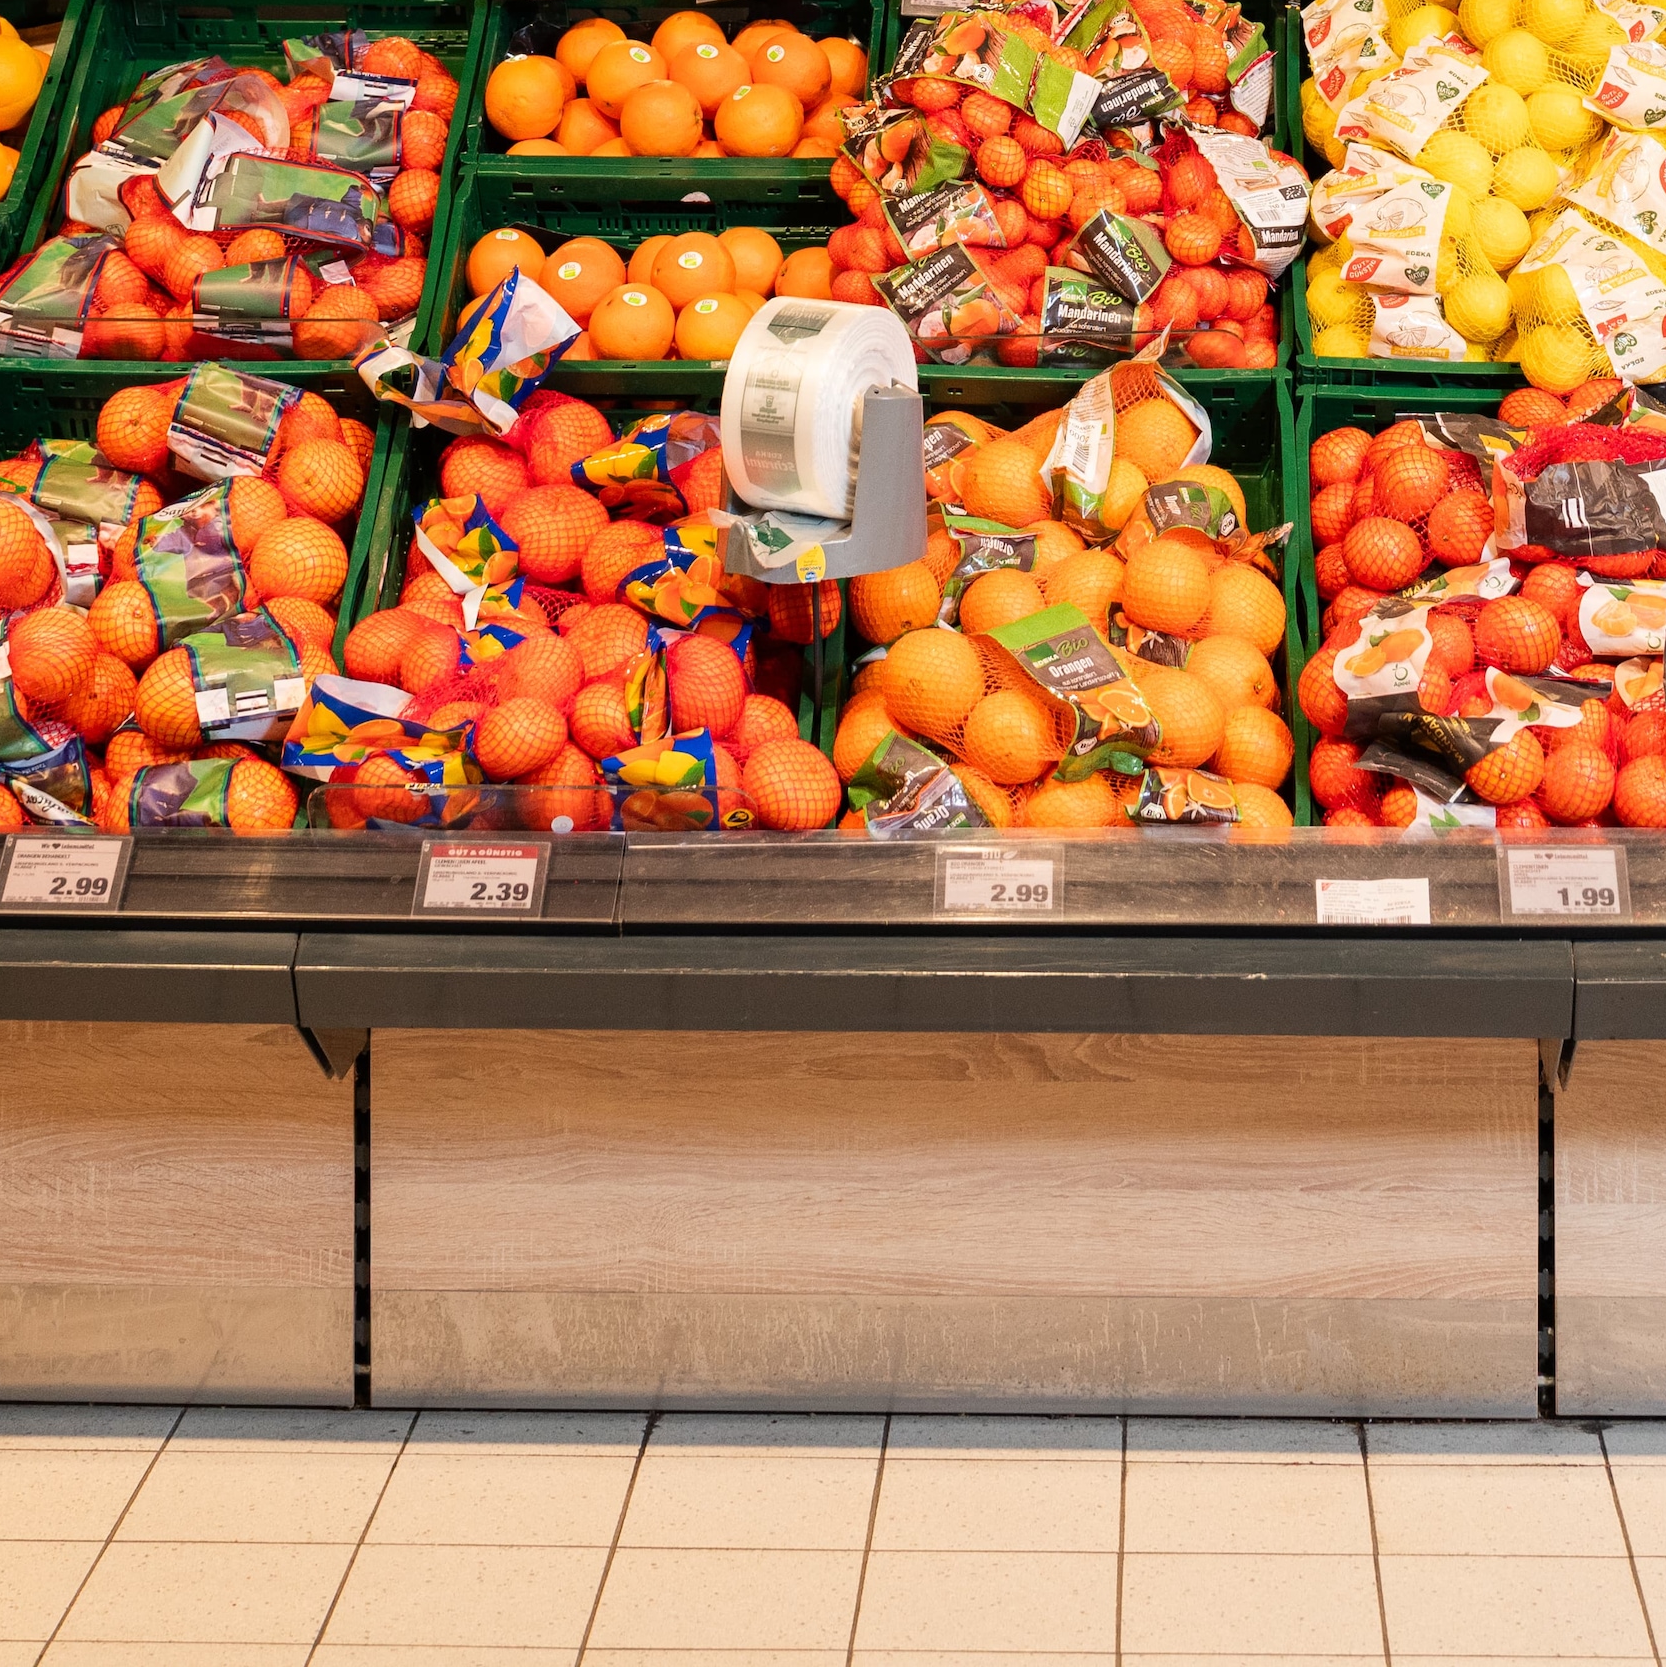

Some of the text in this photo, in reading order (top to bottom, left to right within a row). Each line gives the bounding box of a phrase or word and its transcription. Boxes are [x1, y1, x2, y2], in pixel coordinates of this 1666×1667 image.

[1093, 231, 1142, 288] Mandarinen
[1405, 250, 1432, 258] EDEKA
[897, 253, 955, 299] Mandarinen
[1057, 305, 1122, 324] Mandarinen
[1033, 636, 1089, 668] EDEKA Bio
[1048, 656, 1093, 678] Orangen
[1393, 679, 1411, 688] Apeel
[50, 877, 109, 895] 2.99
[470, 882, 529, 901] 2.39
[991, 884, 1048, 902] 2.99
[1557, 887, 1615, 907] 1.99
